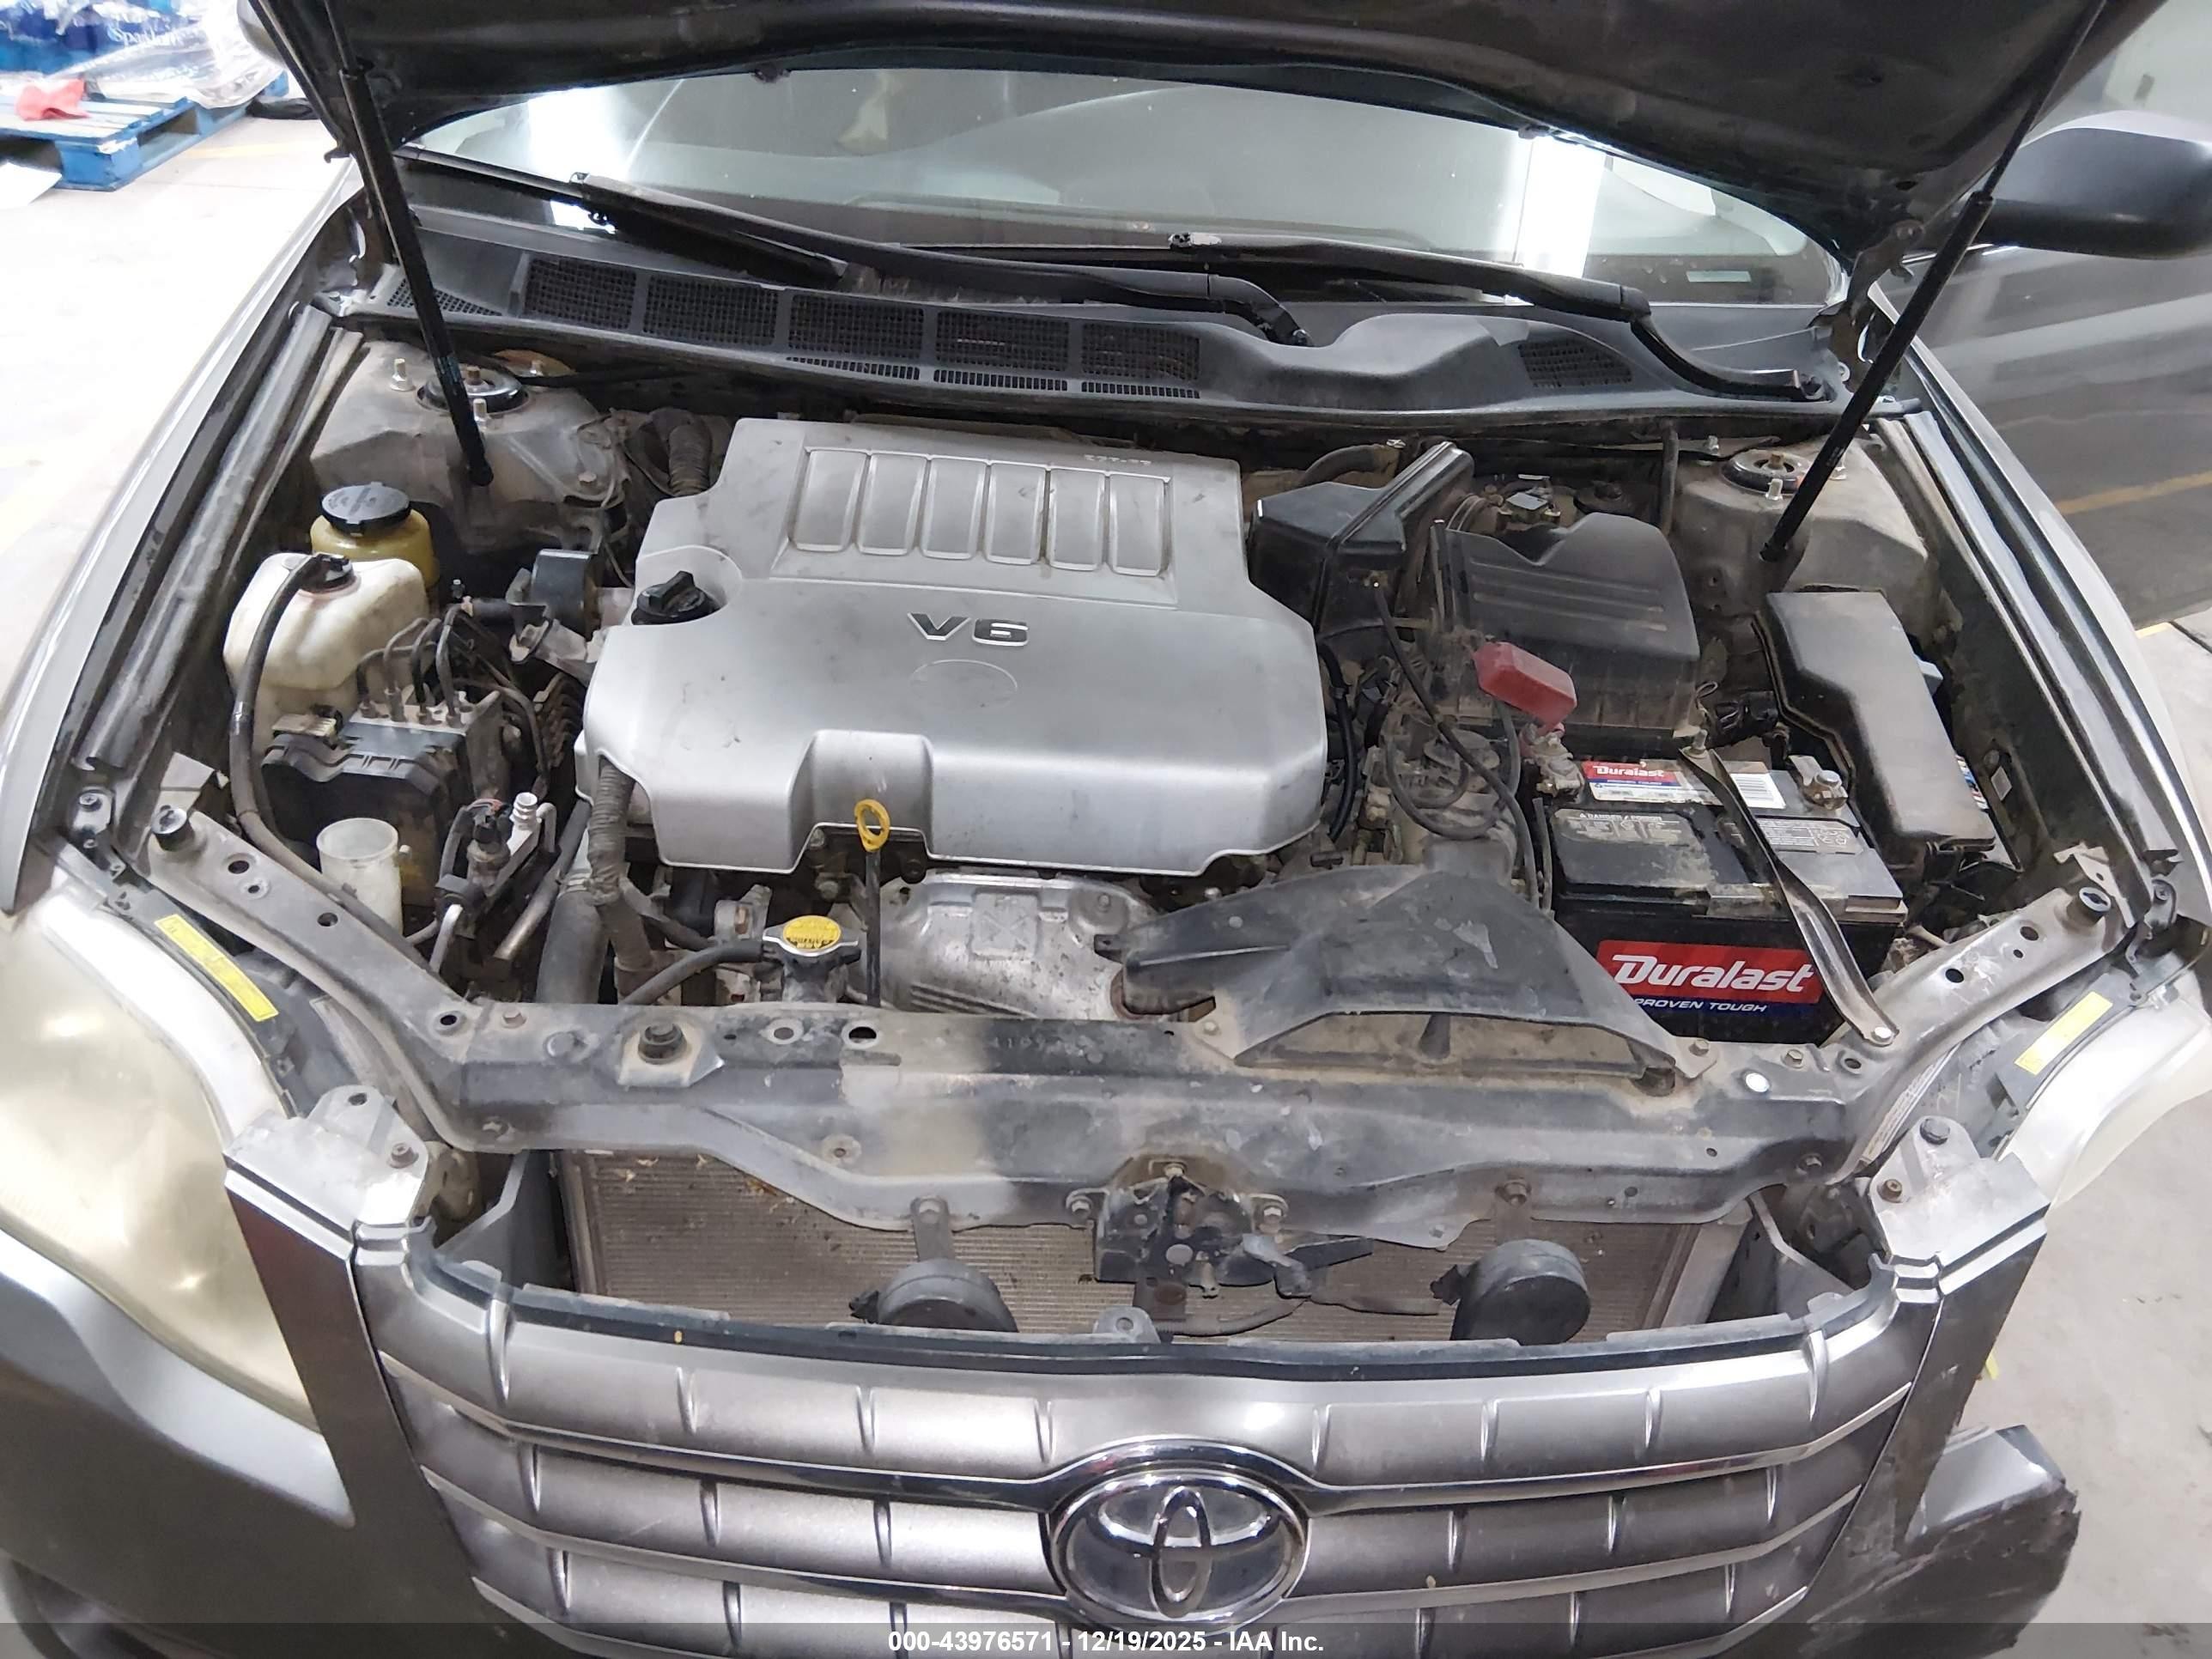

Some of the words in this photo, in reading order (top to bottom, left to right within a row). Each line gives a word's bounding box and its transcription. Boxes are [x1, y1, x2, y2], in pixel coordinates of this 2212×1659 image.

[906, 611, 1029, 647] V6
[1592, 765, 1664, 777] Duralast
[1612, 954, 1814, 993] Duralast
[1633, 998, 1702, 1010] PROVEN
[1709, 1002, 1768, 1012] TOUGH
